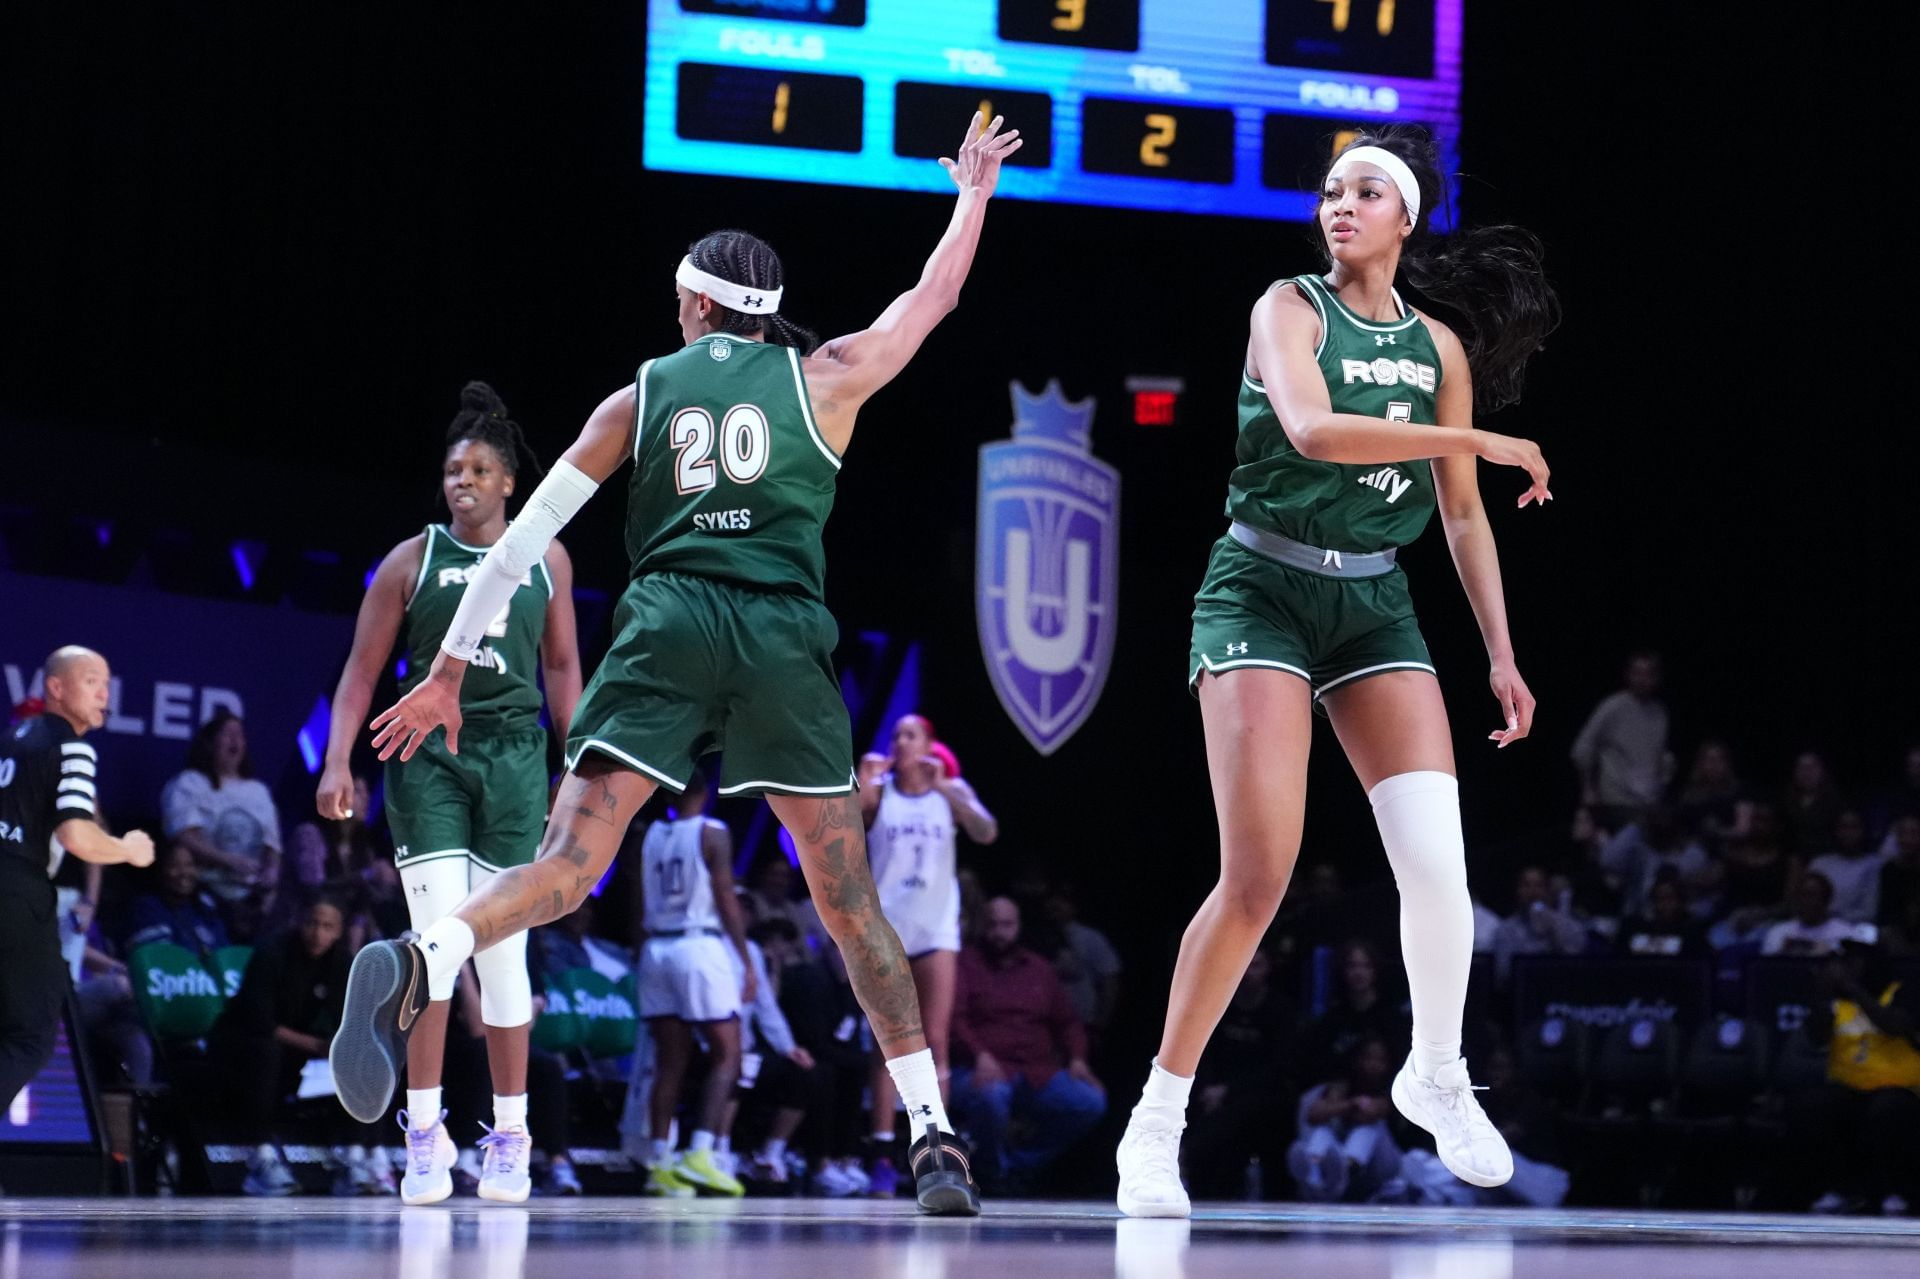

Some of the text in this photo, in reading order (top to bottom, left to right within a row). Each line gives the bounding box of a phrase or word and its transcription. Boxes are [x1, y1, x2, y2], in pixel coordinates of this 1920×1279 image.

[719, 28, 826, 61] FOULS
[942, 48, 1006, 78] TOL
[1128, 64, 1192, 94] TOL
[772, 83, 790, 134] 1
[1299, 79, 1399, 113] FOULS
[1140, 114, 1177, 168] 2
[1341, 357, 1436, 394] ROSE
[669, 403, 770, 495] 20
[692, 508, 751, 531] SYKES
